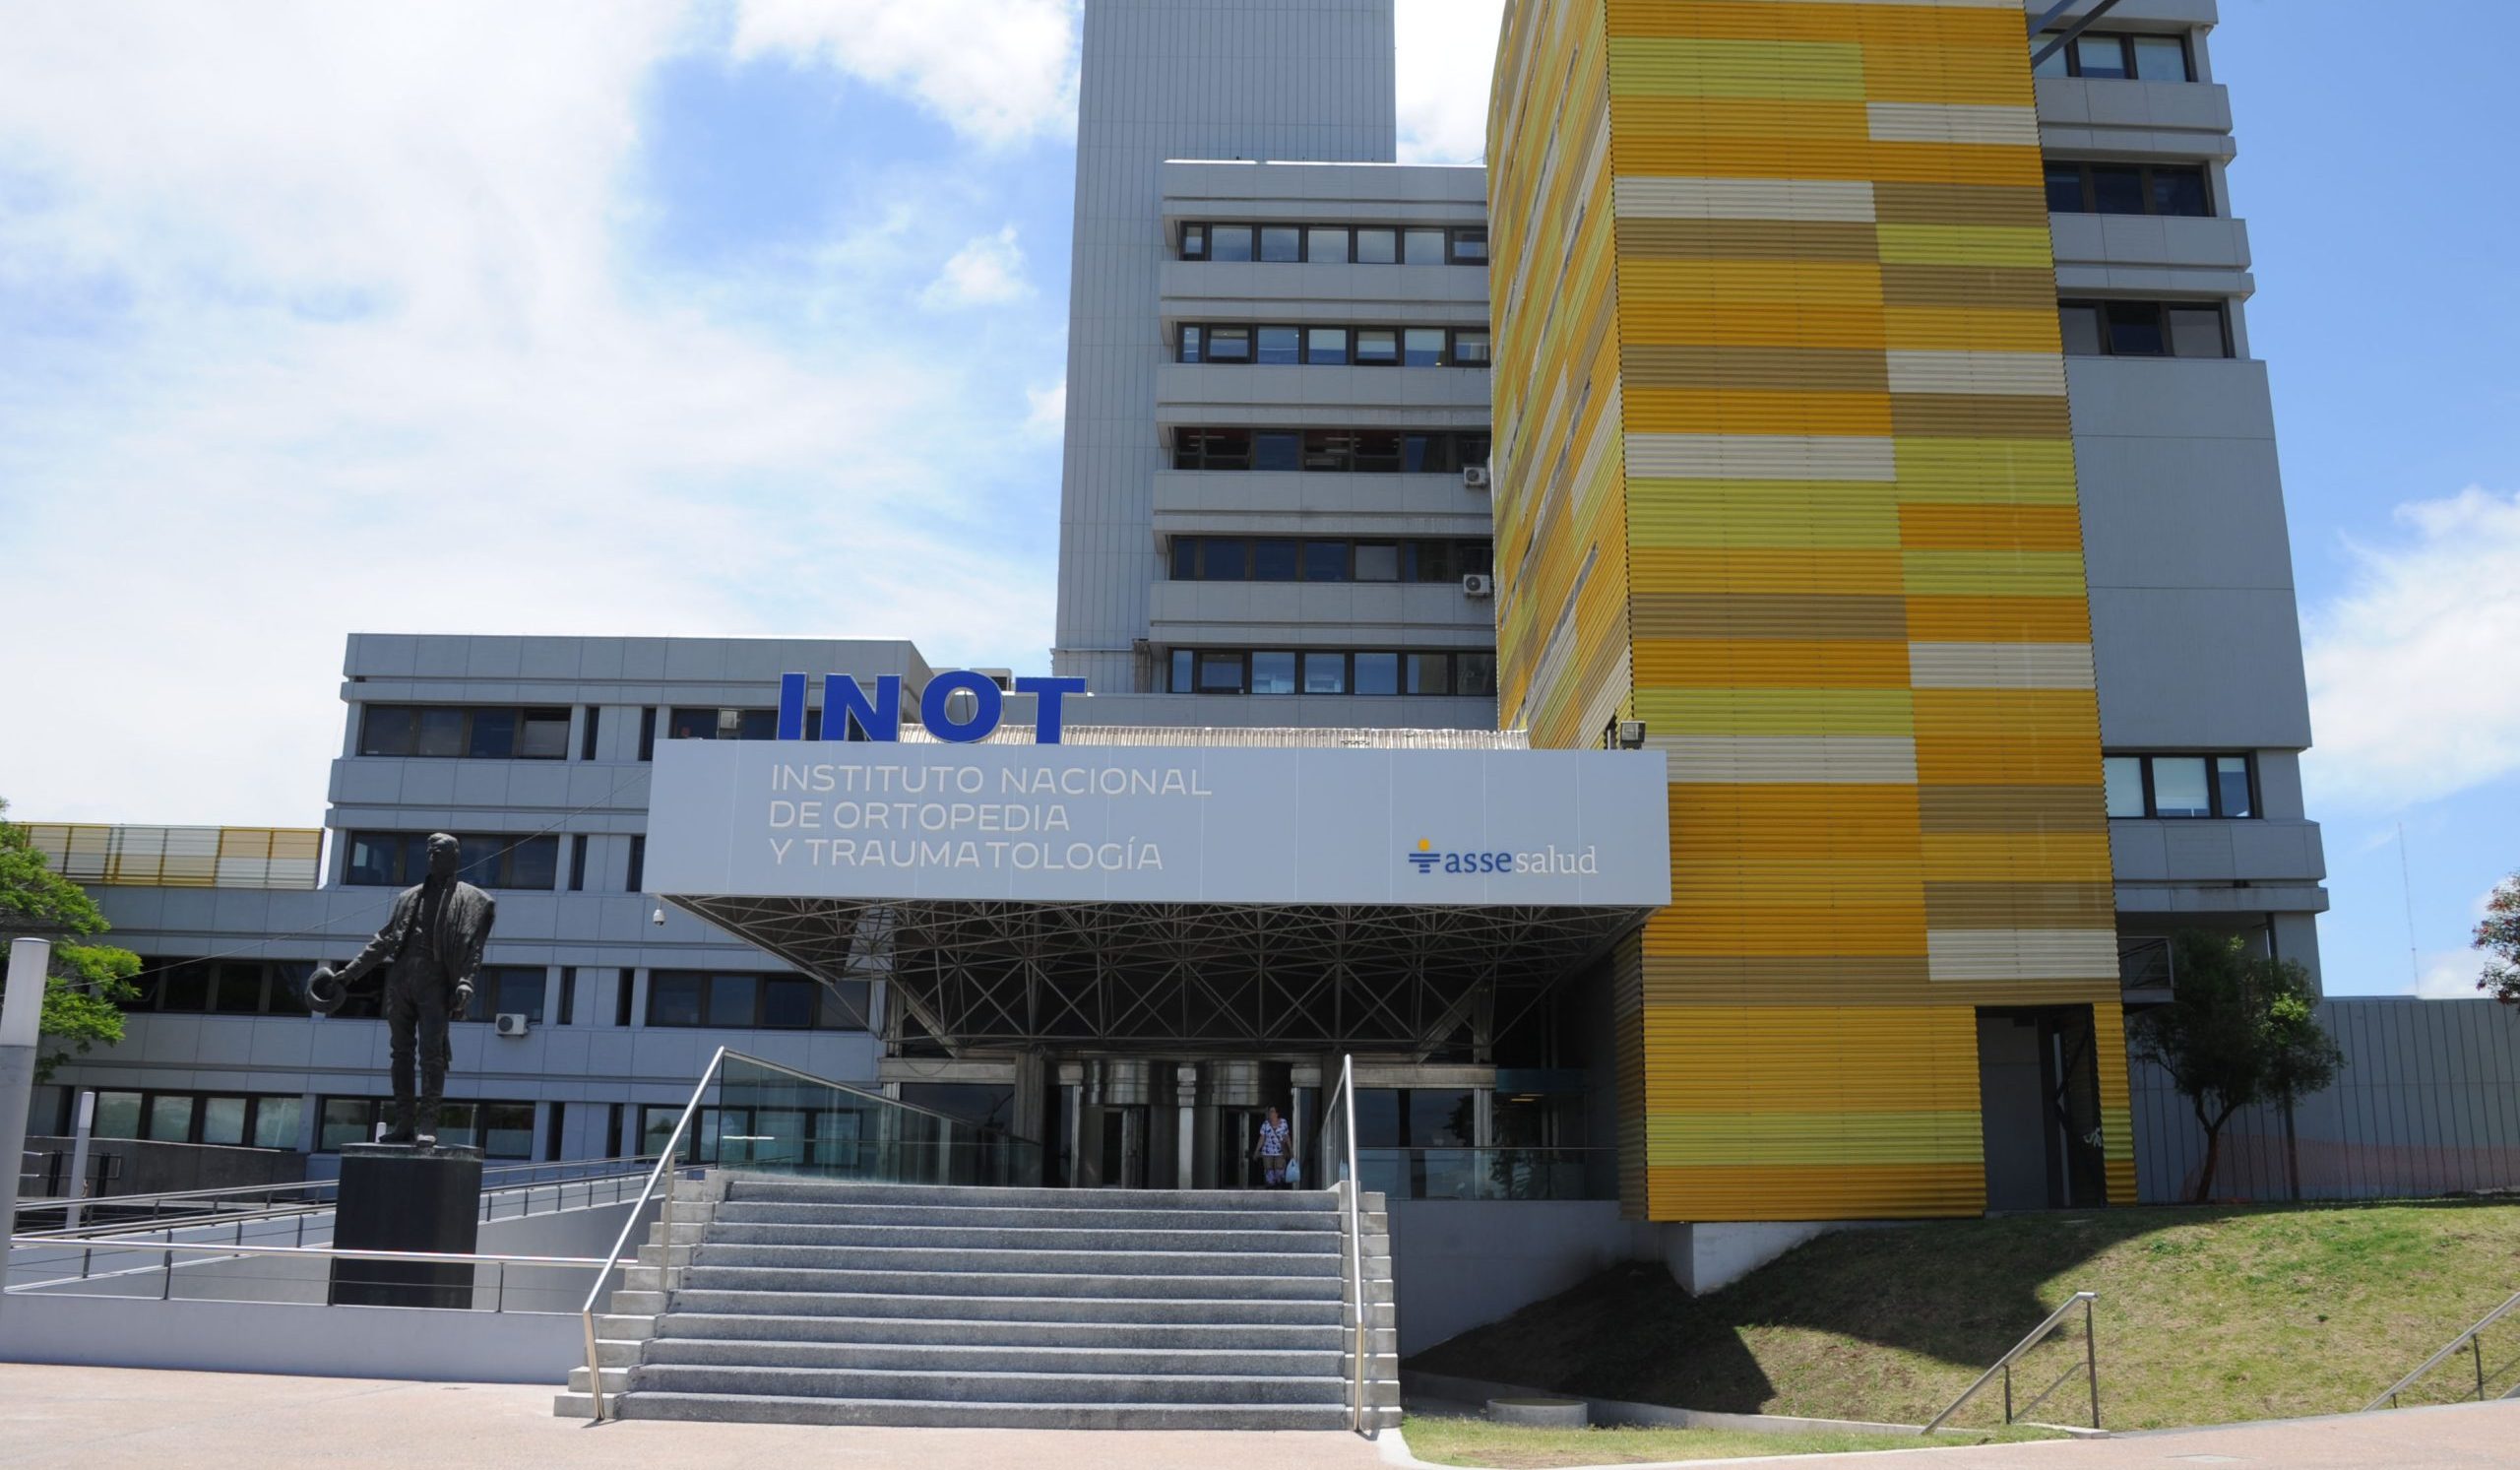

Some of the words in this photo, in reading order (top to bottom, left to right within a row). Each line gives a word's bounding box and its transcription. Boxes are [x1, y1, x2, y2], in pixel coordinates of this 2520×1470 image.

[777, 671, 1087, 744] INOT
[773, 763, 984, 794] INSTITUTO
[1000, 767, 1213, 796] NACIONAL
[770, 799, 822, 829] DE
[834, 800, 1070, 832] ORTOPEDIA
[770, 838, 793, 865] Y
[805, 836, 1164, 870] TRAUMATOLOGÍA
